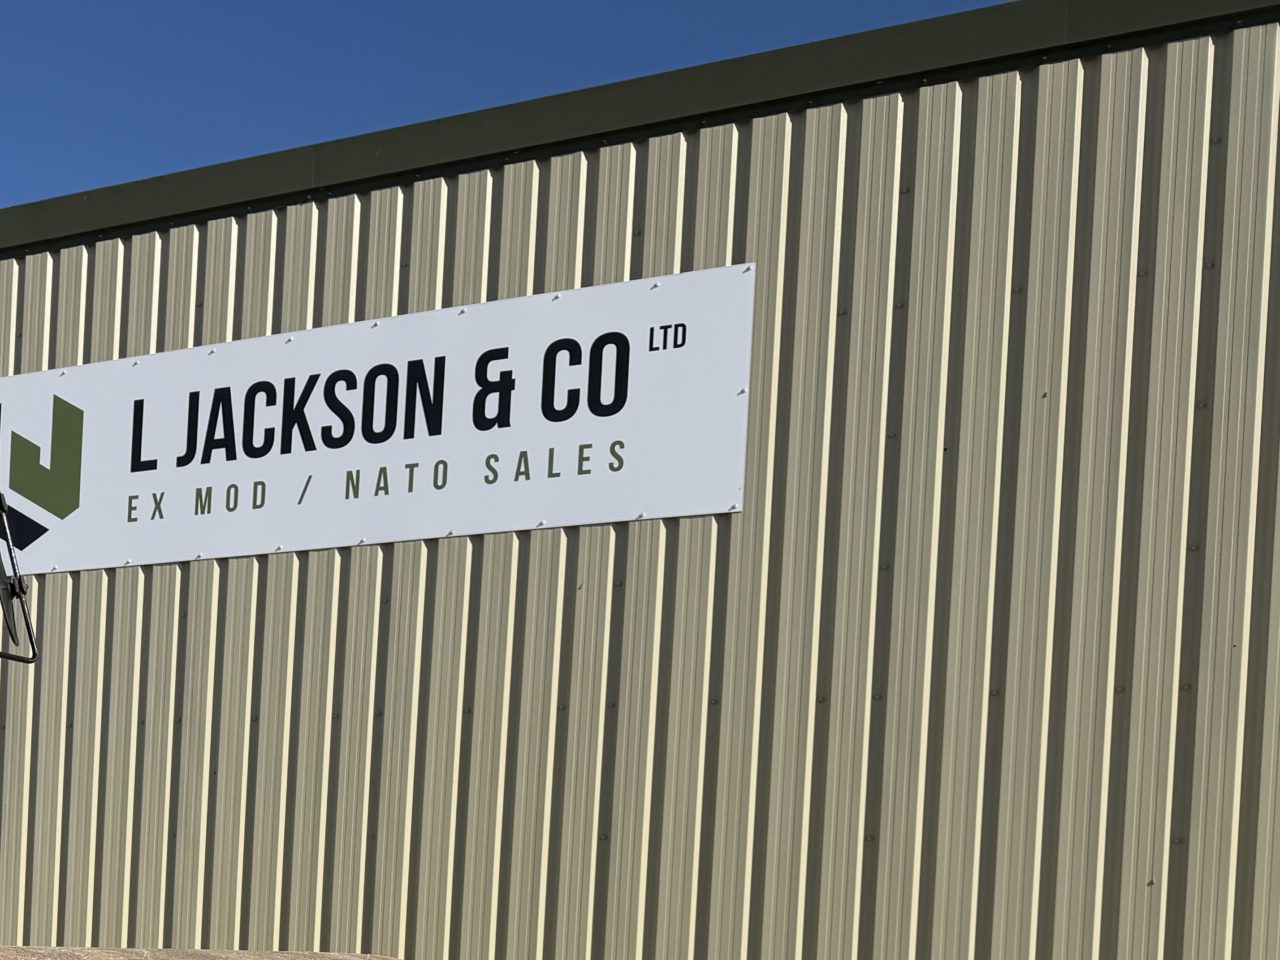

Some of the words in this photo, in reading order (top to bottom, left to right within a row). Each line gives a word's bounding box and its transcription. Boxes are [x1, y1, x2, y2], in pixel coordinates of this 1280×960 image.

[129, 398, 158, 473] L
[175, 355, 447, 468] JACKSON
[471, 346, 516, 432] &
[540, 331, 631, 423] CO
[648, 322, 687, 353] LTD
[127, 491, 165, 523] EX
[194, 480, 267, 516] MOD
[344, 459, 449, 500] NATO
[483, 440, 625, 485] SALES
